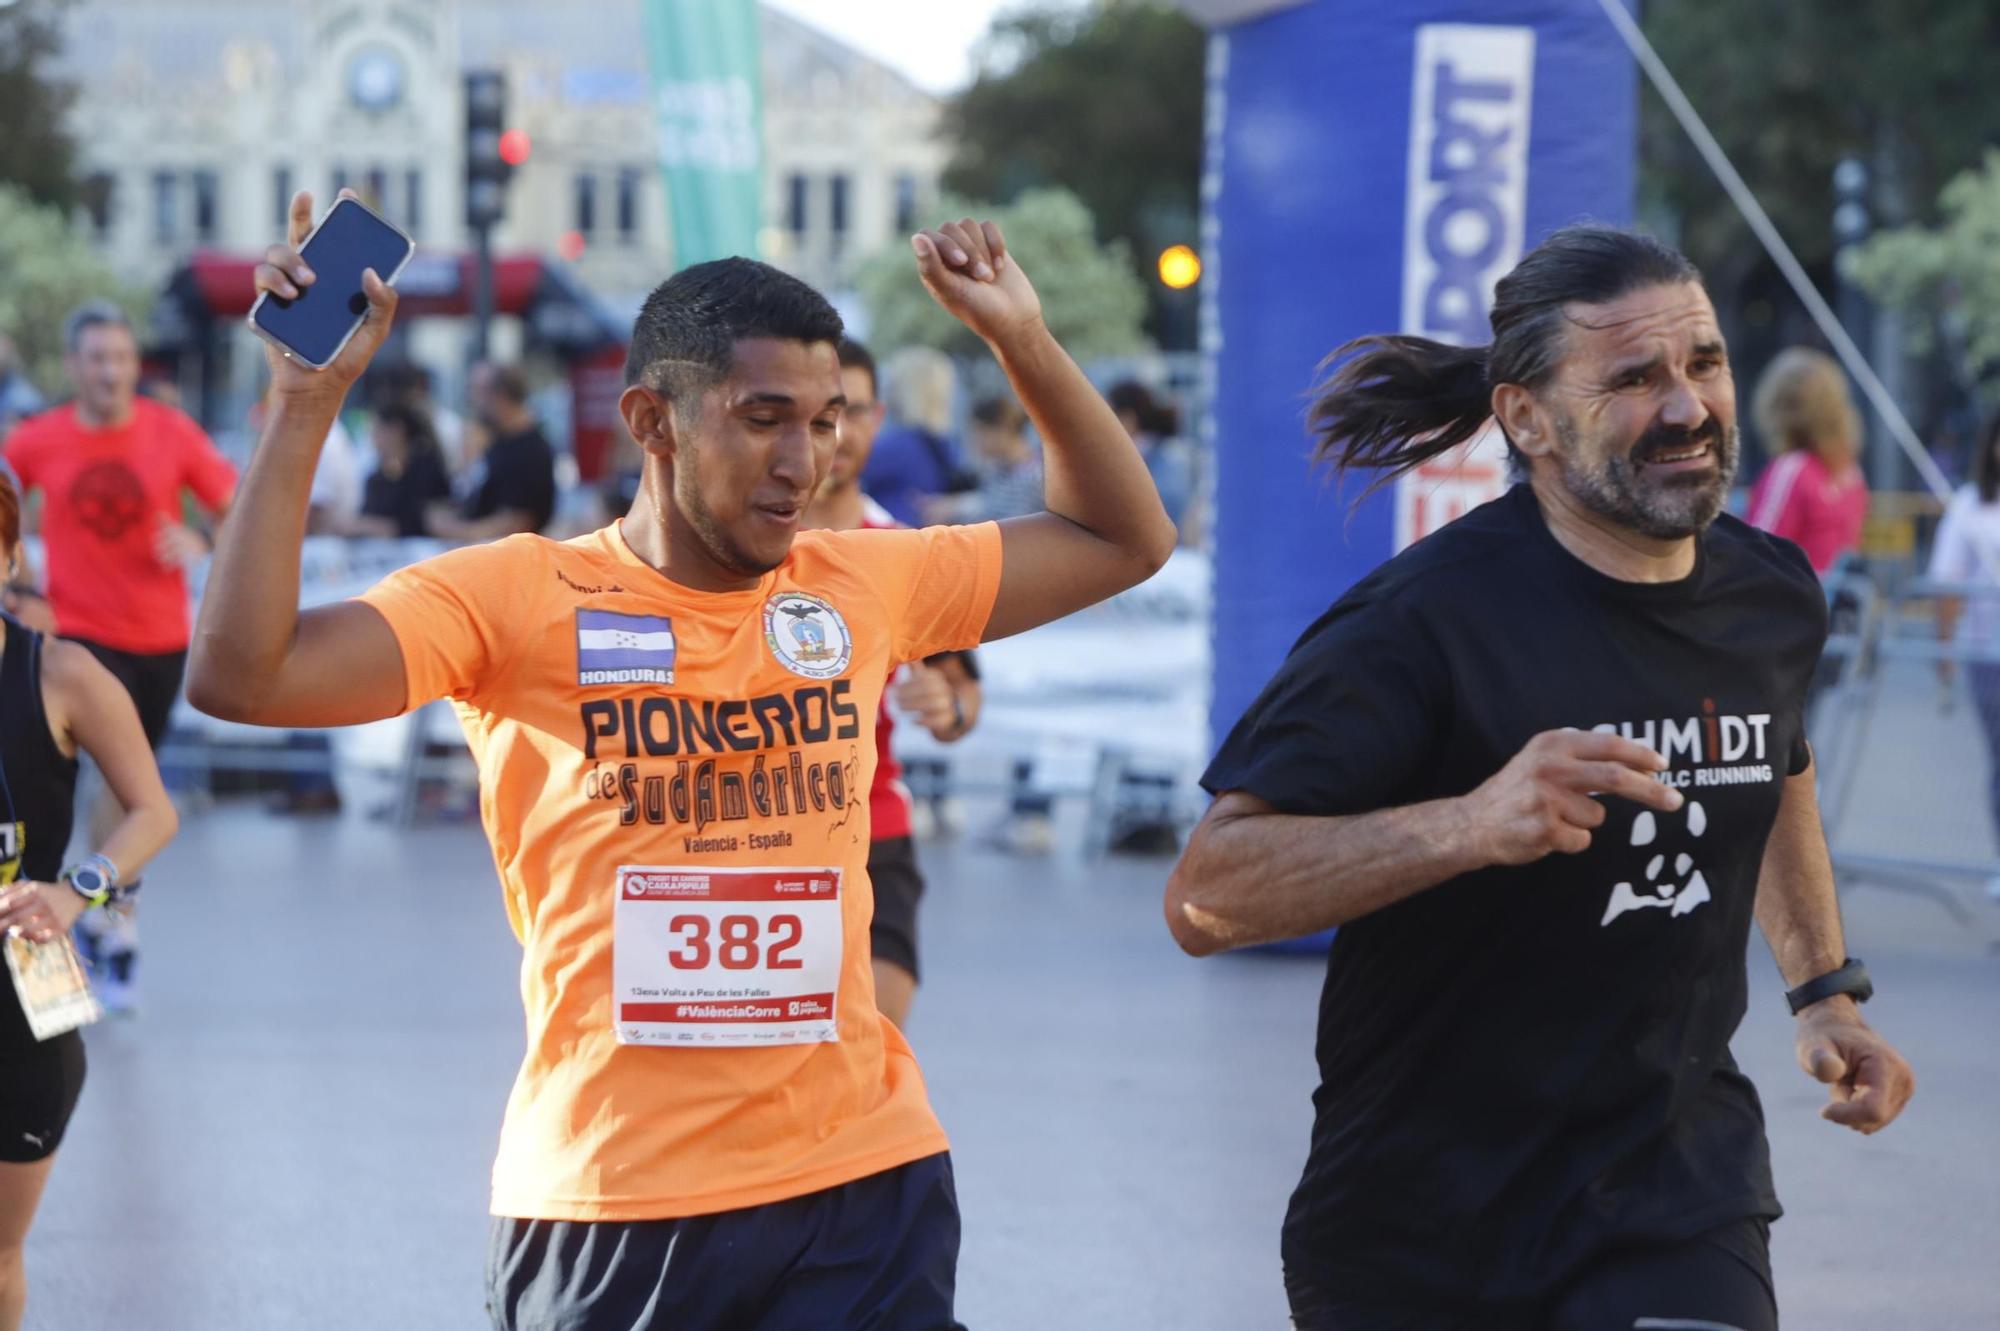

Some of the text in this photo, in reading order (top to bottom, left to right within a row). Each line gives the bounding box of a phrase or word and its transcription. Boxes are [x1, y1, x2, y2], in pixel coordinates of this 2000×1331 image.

[581, 679, 859, 759] PIONEROS
[1695, 765, 1773, 786] RUNNING
[586, 751, 846, 834] de SudAmérica
[683, 837, 738, 854] Valencia
[748, 830, 793, 850] España
[668, 914, 803, 970] 382
[661, 988, 687, 996] Volta
[697, 988, 715, 996] Peu
[717, 988, 727, 996] de
[729, 988, 742, 996] les
[744, 988, 771, 997] Falles
[676, 1003, 781, 1018] #ValènciaCorre
